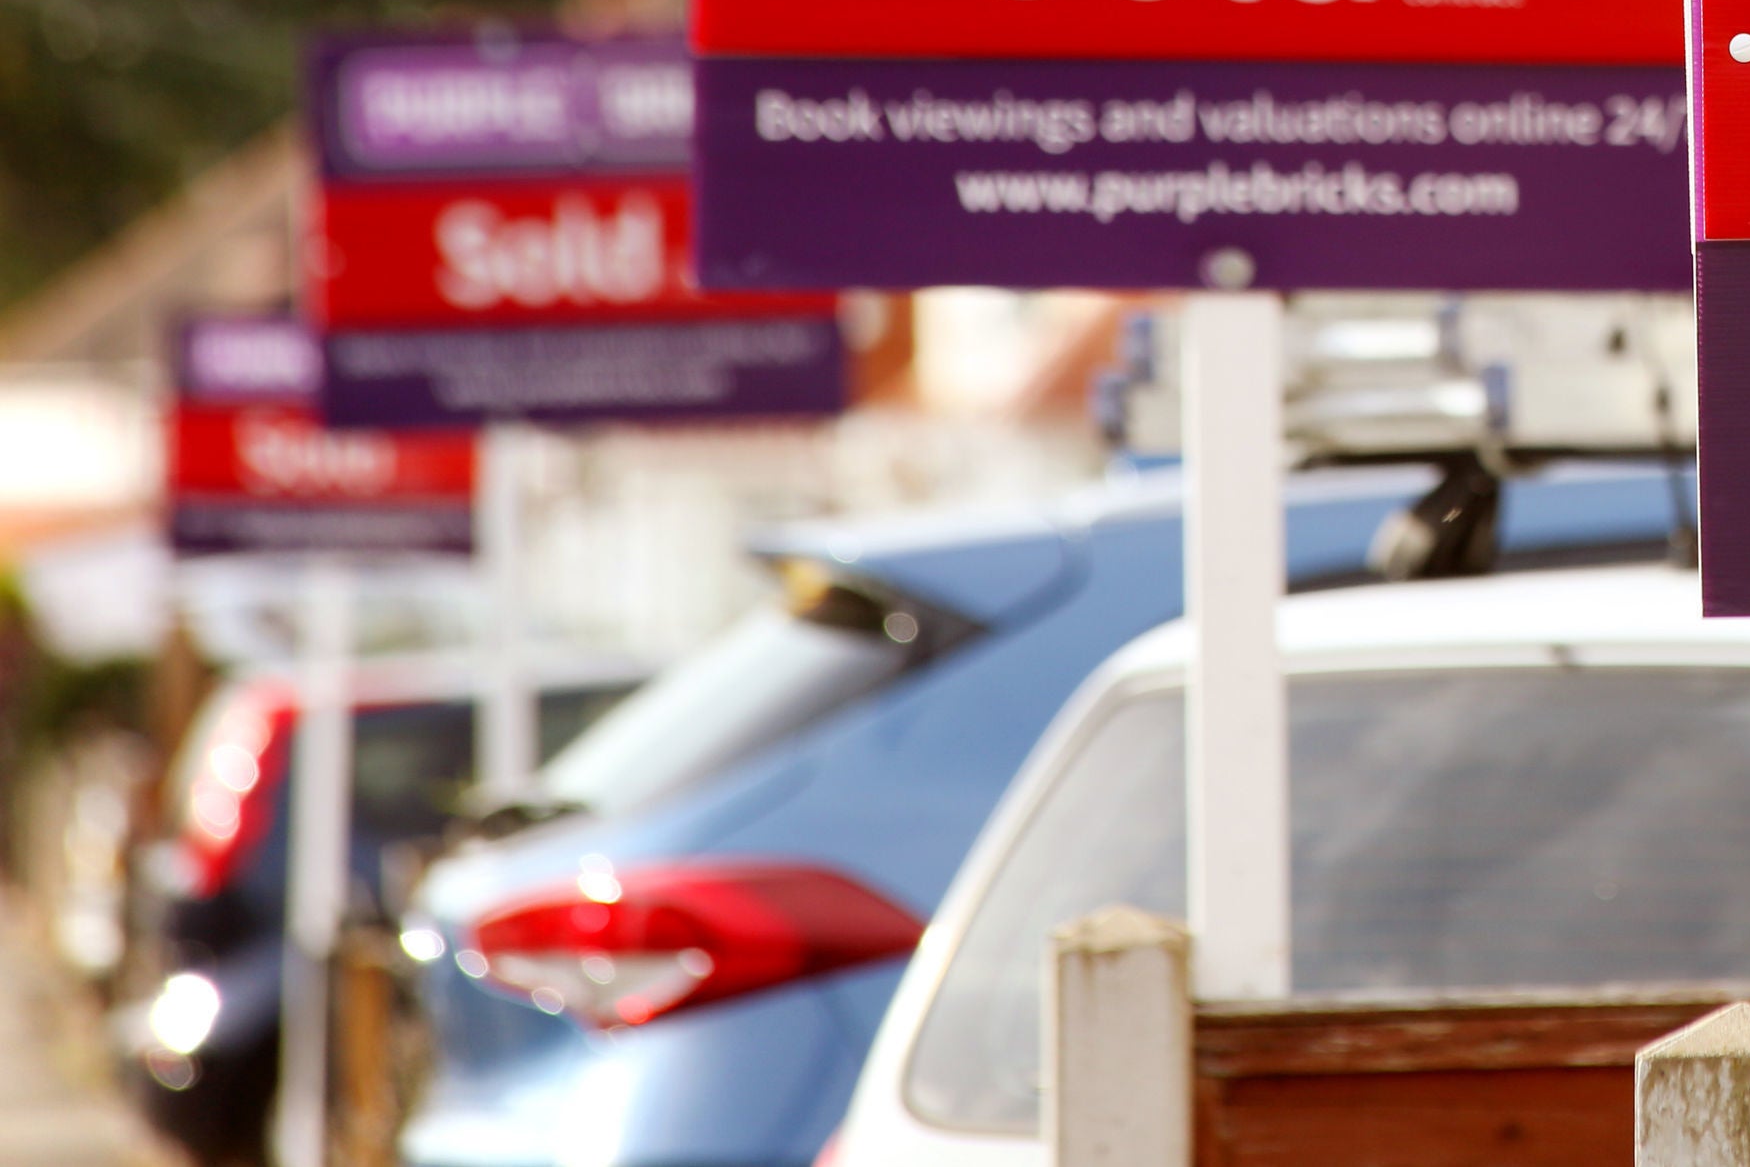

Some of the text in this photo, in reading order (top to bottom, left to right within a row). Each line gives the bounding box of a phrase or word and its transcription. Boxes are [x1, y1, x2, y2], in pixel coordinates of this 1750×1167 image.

[756, 89, 880, 142] Book
[885, 89, 1096, 154] viewings
[1099, 89, 1195, 143] and
[1199, 90, 1447, 145] valuations
[1449, 92, 1602, 146] online
[954, 160, 1519, 224] www.purplebricks.com
